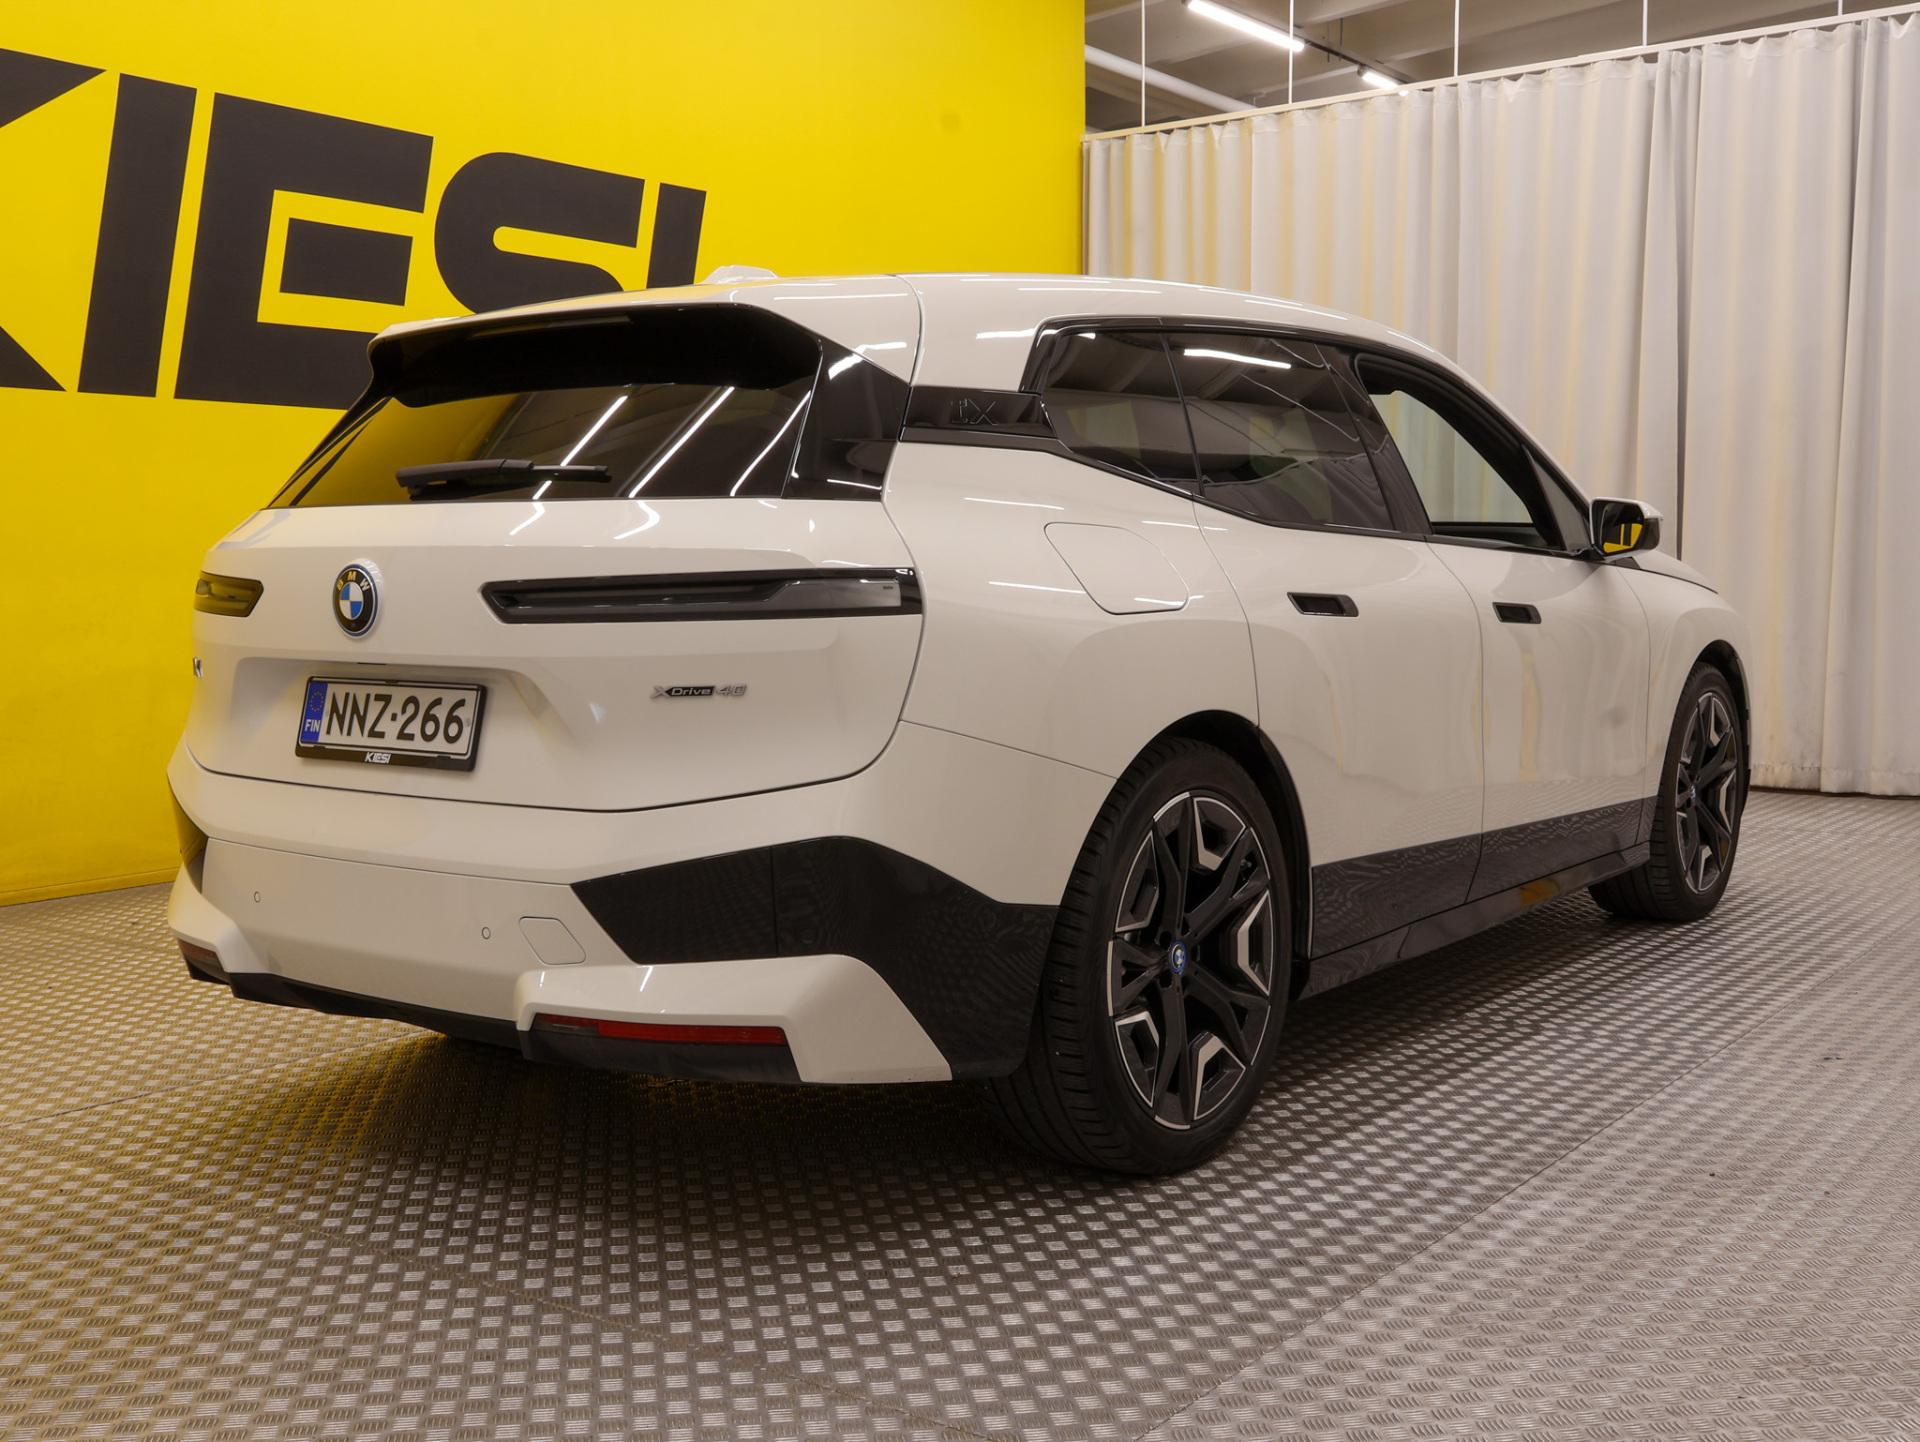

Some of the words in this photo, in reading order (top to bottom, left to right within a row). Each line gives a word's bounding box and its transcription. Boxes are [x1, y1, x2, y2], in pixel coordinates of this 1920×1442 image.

[337, 570, 371, 592] BMW
[304, 718, 321, 733] FIN
[364, 751, 392, 765] KIESI
